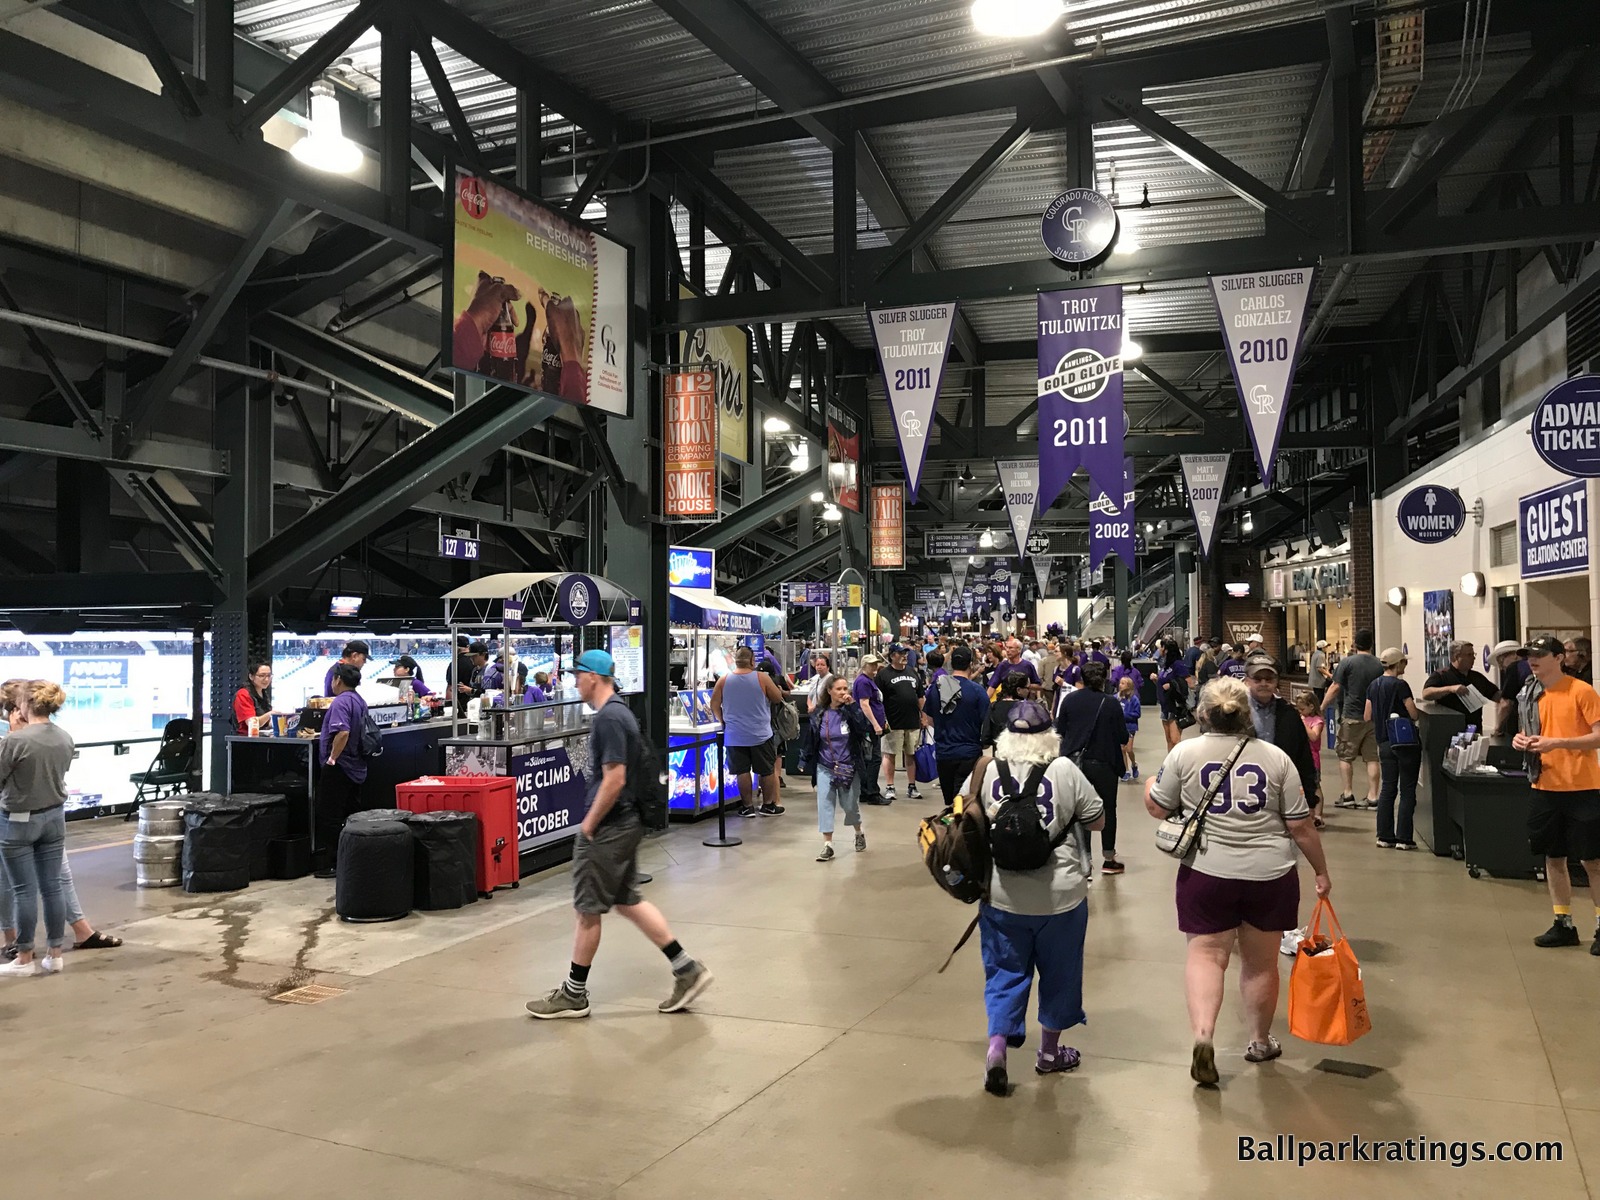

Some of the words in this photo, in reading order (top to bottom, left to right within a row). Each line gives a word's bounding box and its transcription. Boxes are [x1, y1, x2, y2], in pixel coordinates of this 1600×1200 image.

[1045, 190, 1081, 220] COLORADO
[1082, 191, 1110, 214] ROCKIES
[547, 226, 587, 254] CROWD
[526, 232, 588, 271] REFRESHER
[1054, 246, 1078, 260] SINCE
[1221, 277, 1255, 291] SILVER
[1258, 272, 1304, 288] SLUGGER
[1061, 297, 1098, 315] TROY
[1240, 294, 1285, 311] CARLOS
[878, 310, 907, 324] SILVER
[909, 307, 947, 322] SLUGGER
[1234, 310, 1292, 328] GONZALEZ
[1039, 314, 1121, 335] TULOWITZKI
[900, 328, 926, 342] TROY
[882, 341, 944, 359] TULOWITZKI
[1239, 337, 1288, 364] 2010
[1064, 354, 1093, 369] RAWLINGS
[676, 373, 712, 393] 112
[895, 367, 931, 391] 2011
[1044, 373, 1076, 391] GOLD
[1080, 358, 1120, 380] GLOVE
[1073, 381, 1096, 395] AWARD
[668, 395, 711, 421] BLUE
[1541, 401, 1600, 427] ADVA
[668, 421, 711, 445] MOON
[1053, 416, 1108, 447] 2011
[668, 445, 711, 453] BREWING
[668, 452, 711, 461] COMPANY
[1203, 455, 1226, 463] SLUGGER
[1191, 474, 1219, 482] HOLLIDAY
[1196, 466, 1214, 474] MATT
[668, 471, 711, 499] SMOKE
[877, 487, 901, 497] 106
[1010, 479, 1032, 488] HELTON
[1008, 493, 1034, 505] 2002
[1192, 487, 1219, 500] 2007
[668, 499, 712, 511] HOUSE
[873, 499, 900, 519] FAIR
[1092, 499, 1110, 509] GOLD
[1407, 515, 1455, 530] WOMEN
[1527, 490, 1585, 544] GUEST
[1095, 523, 1129, 538] 2002
[445, 539, 458, 556] 127
[464, 541, 477, 558] 126
[1527, 542, 1560, 566] RELATIONS
[1560, 537, 1588, 561] CENTER
[992, 585, 1009, 593] 2004
[504, 608, 521, 620] ENTER
[717, 613, 729, 627] ICE
[730, 615, 752, 629] CREAM
[1232, 624, 1258, 632] ROX
[377, 712, 397, 722] LIGHT
[516, 772, 533, 793] WE
[534, 765, 571, 789] CLIMB
[1199, 760, 1269, 815] 93
[517, 808, 569, 840] OCTOBER
